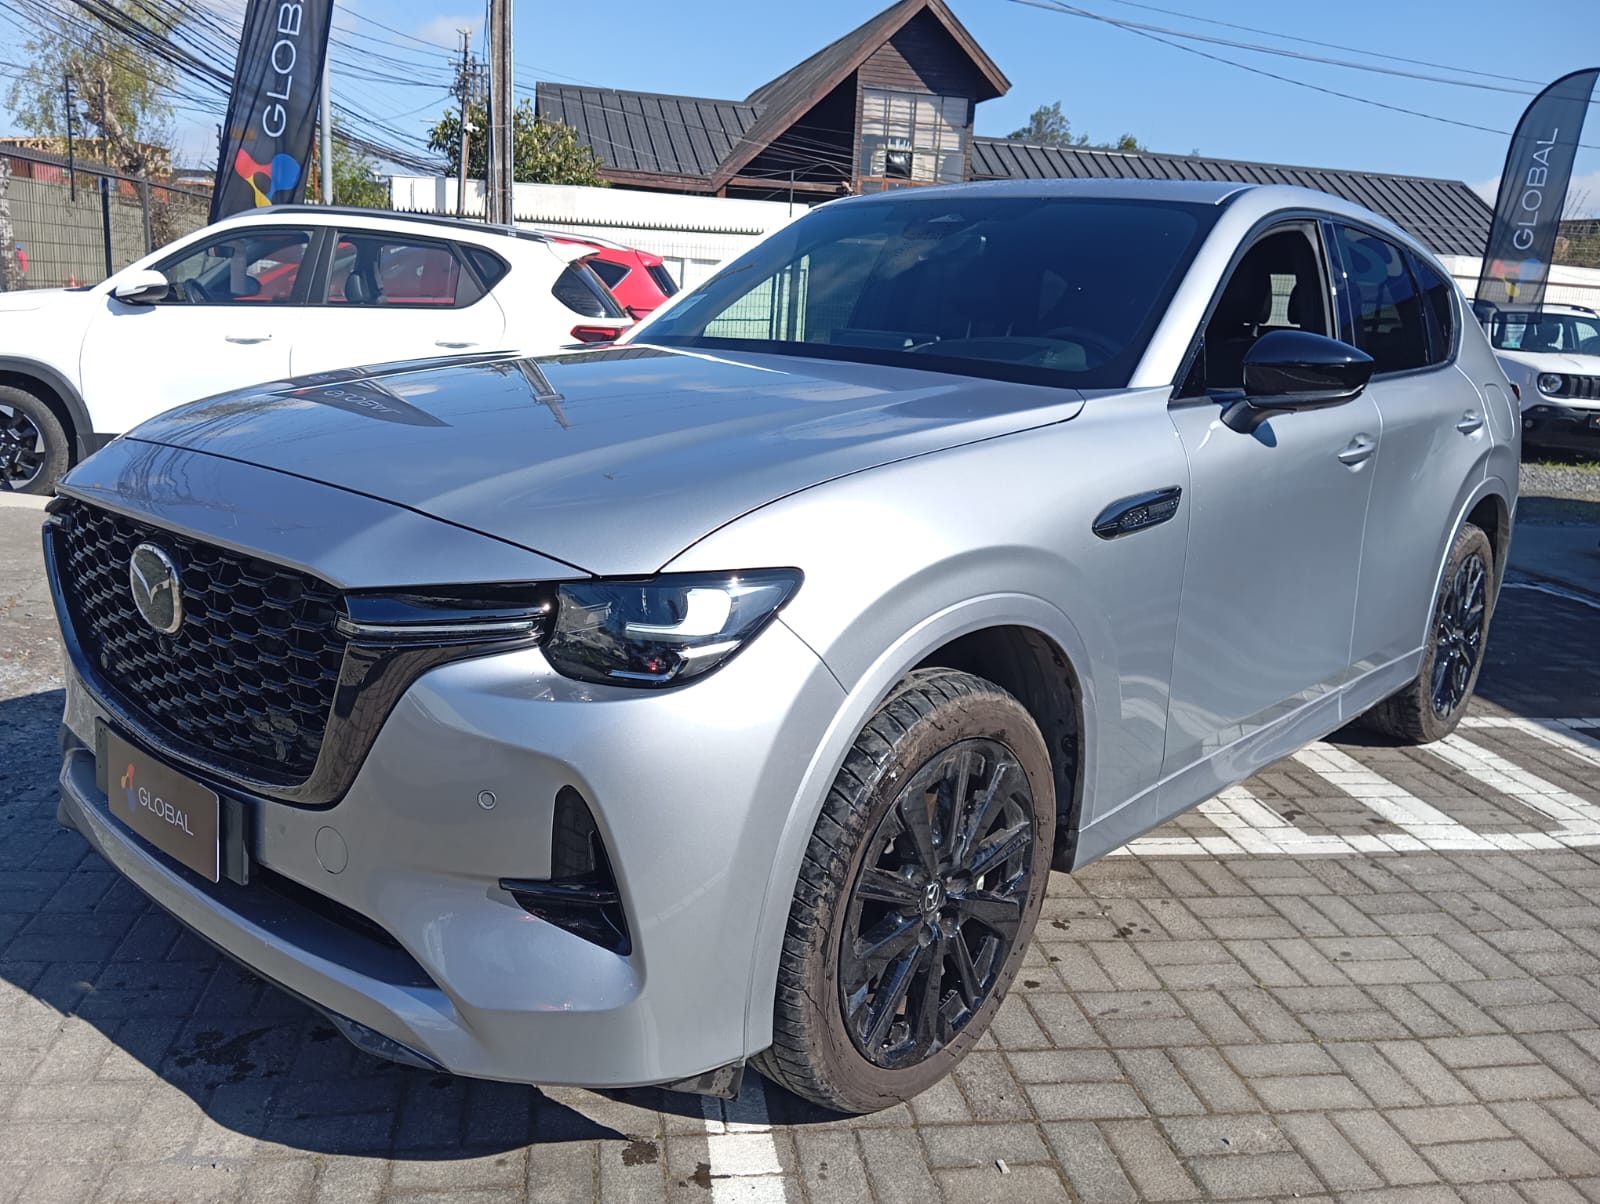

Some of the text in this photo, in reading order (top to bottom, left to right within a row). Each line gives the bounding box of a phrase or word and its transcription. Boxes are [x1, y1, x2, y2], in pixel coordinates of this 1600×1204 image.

[262, 0, 304, 138] GLOB
[1513, 127, 1559, 250] GLOBAL
[138, 787, 194, 836] GLOBAL
